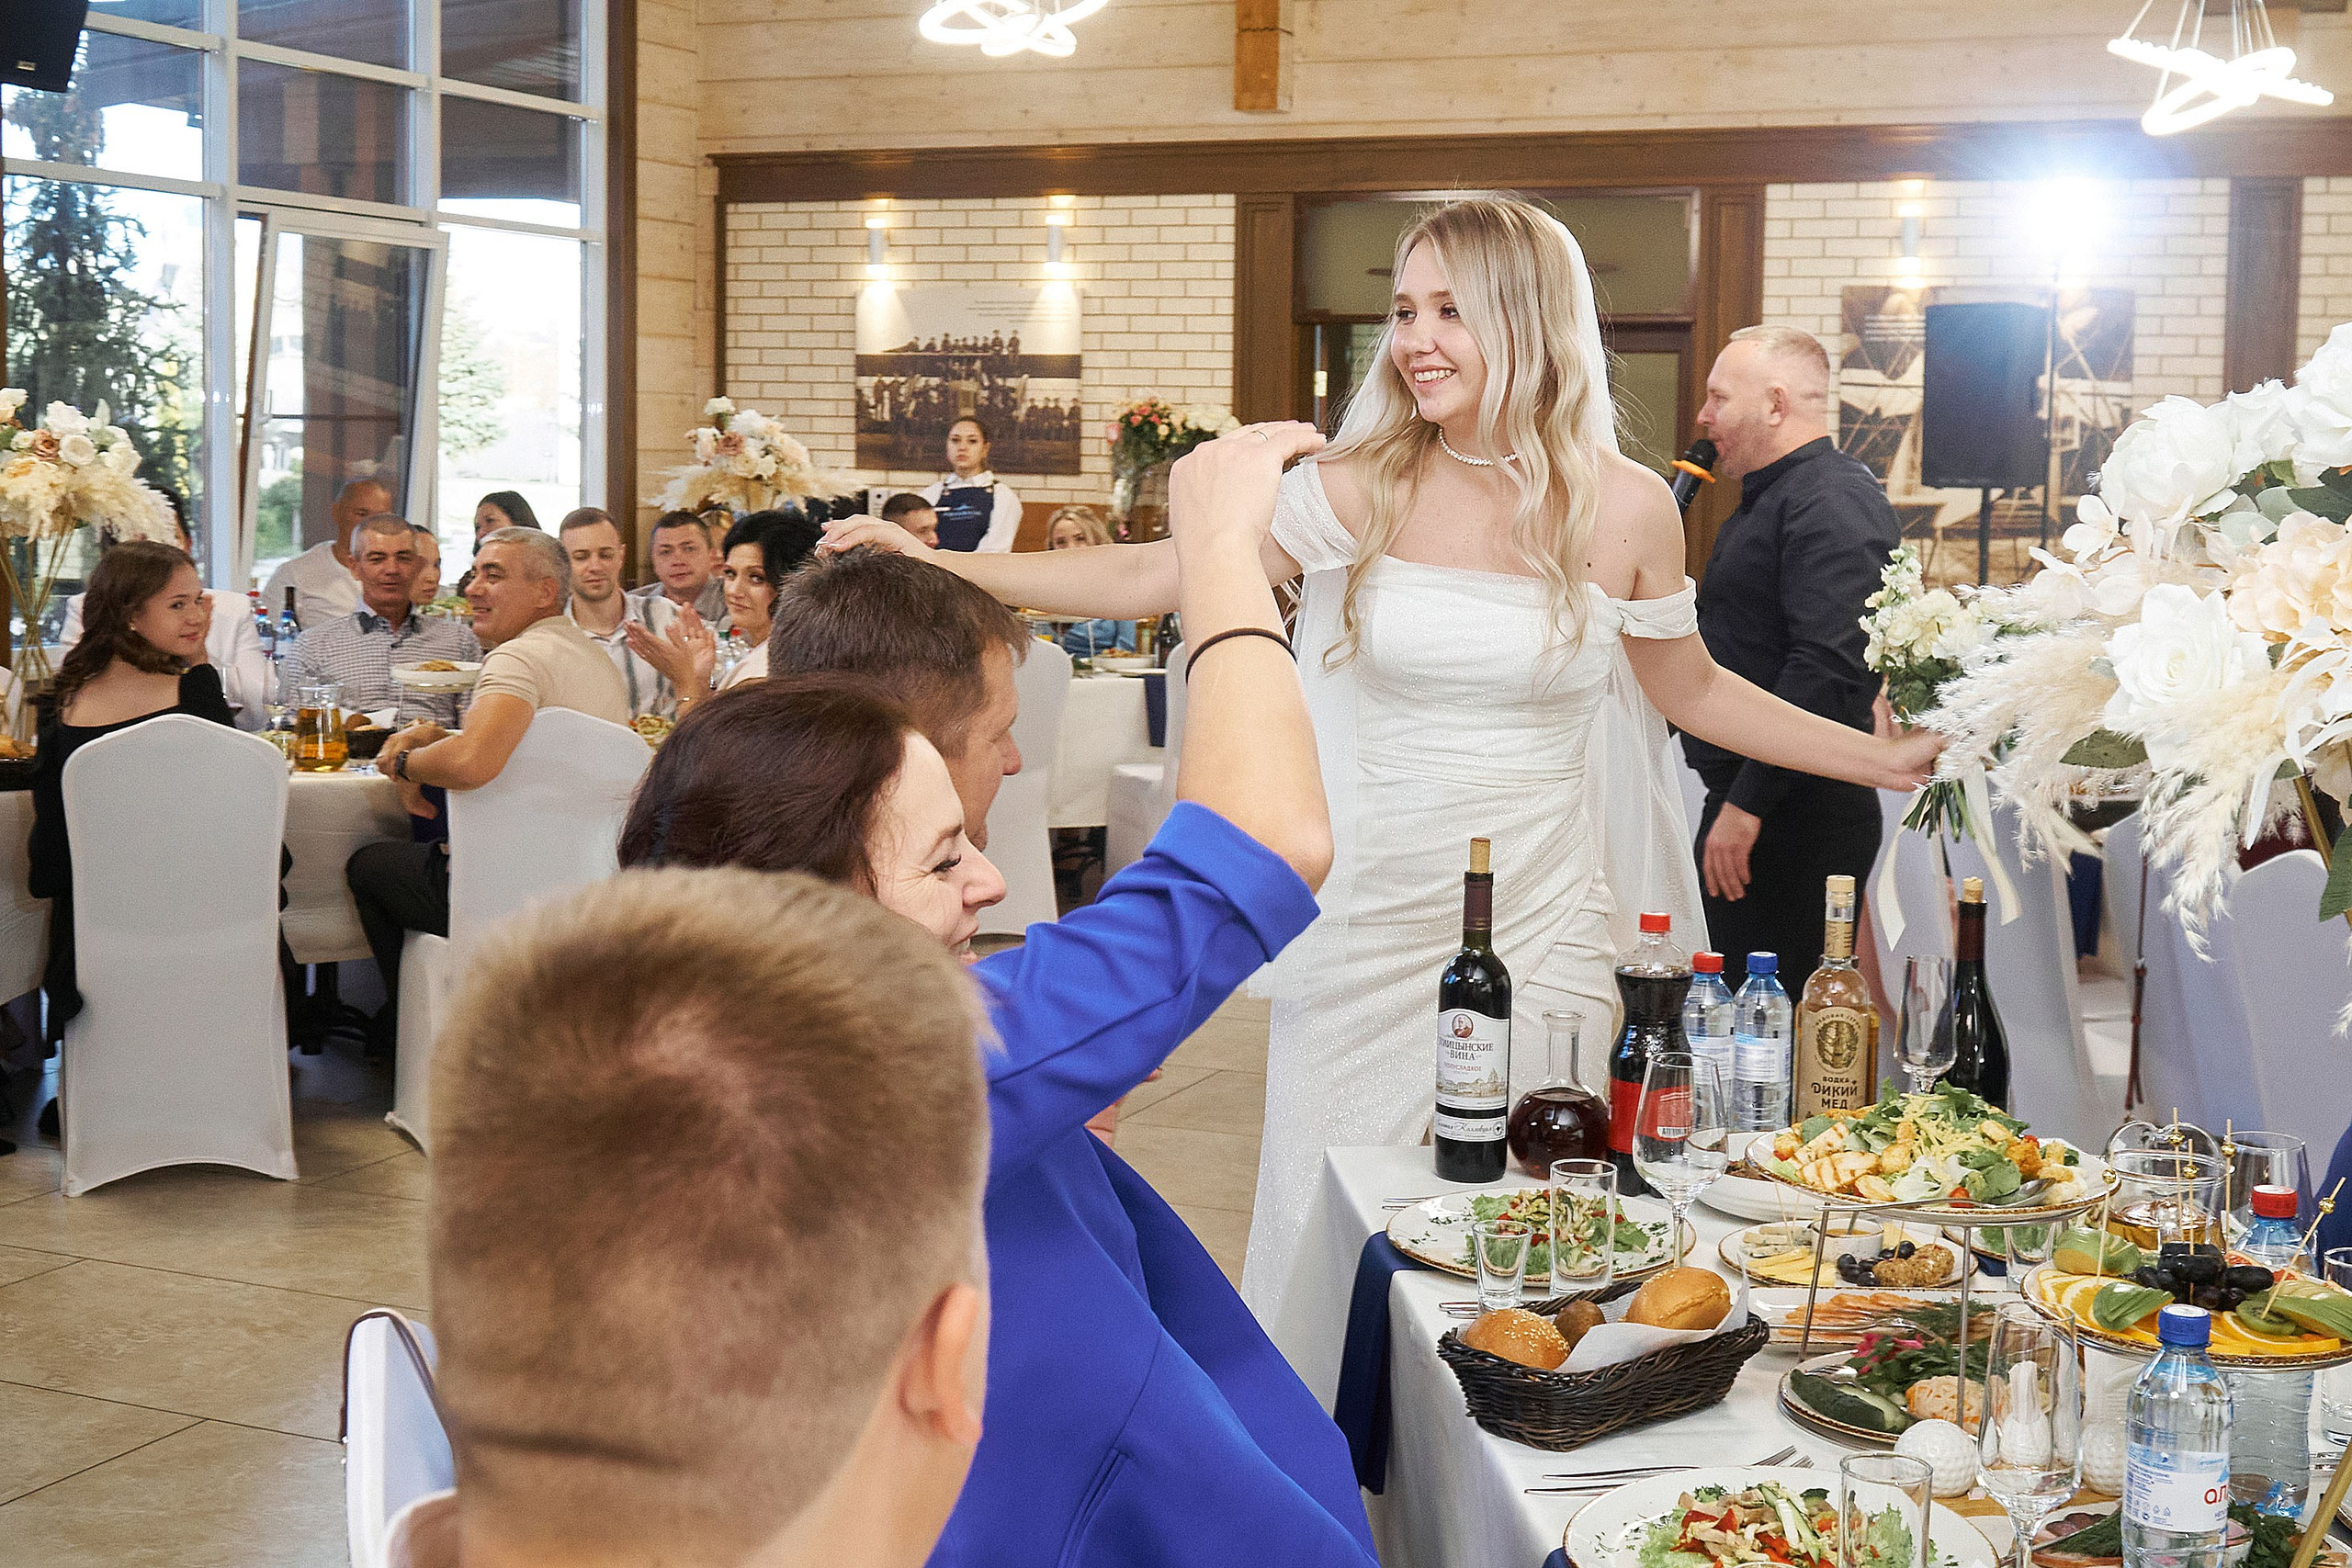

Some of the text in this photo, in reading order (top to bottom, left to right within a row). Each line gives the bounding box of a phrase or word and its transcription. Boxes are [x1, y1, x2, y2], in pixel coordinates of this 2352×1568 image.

[1450, 1049, 1475, 1061] ВИНА
[1823, 1076, 1849, 1084] ВОДКА
[1811, 1079, 1858, 1098] ДИКИЙ
[1821, 1098, 1849, 1110] МЕД
